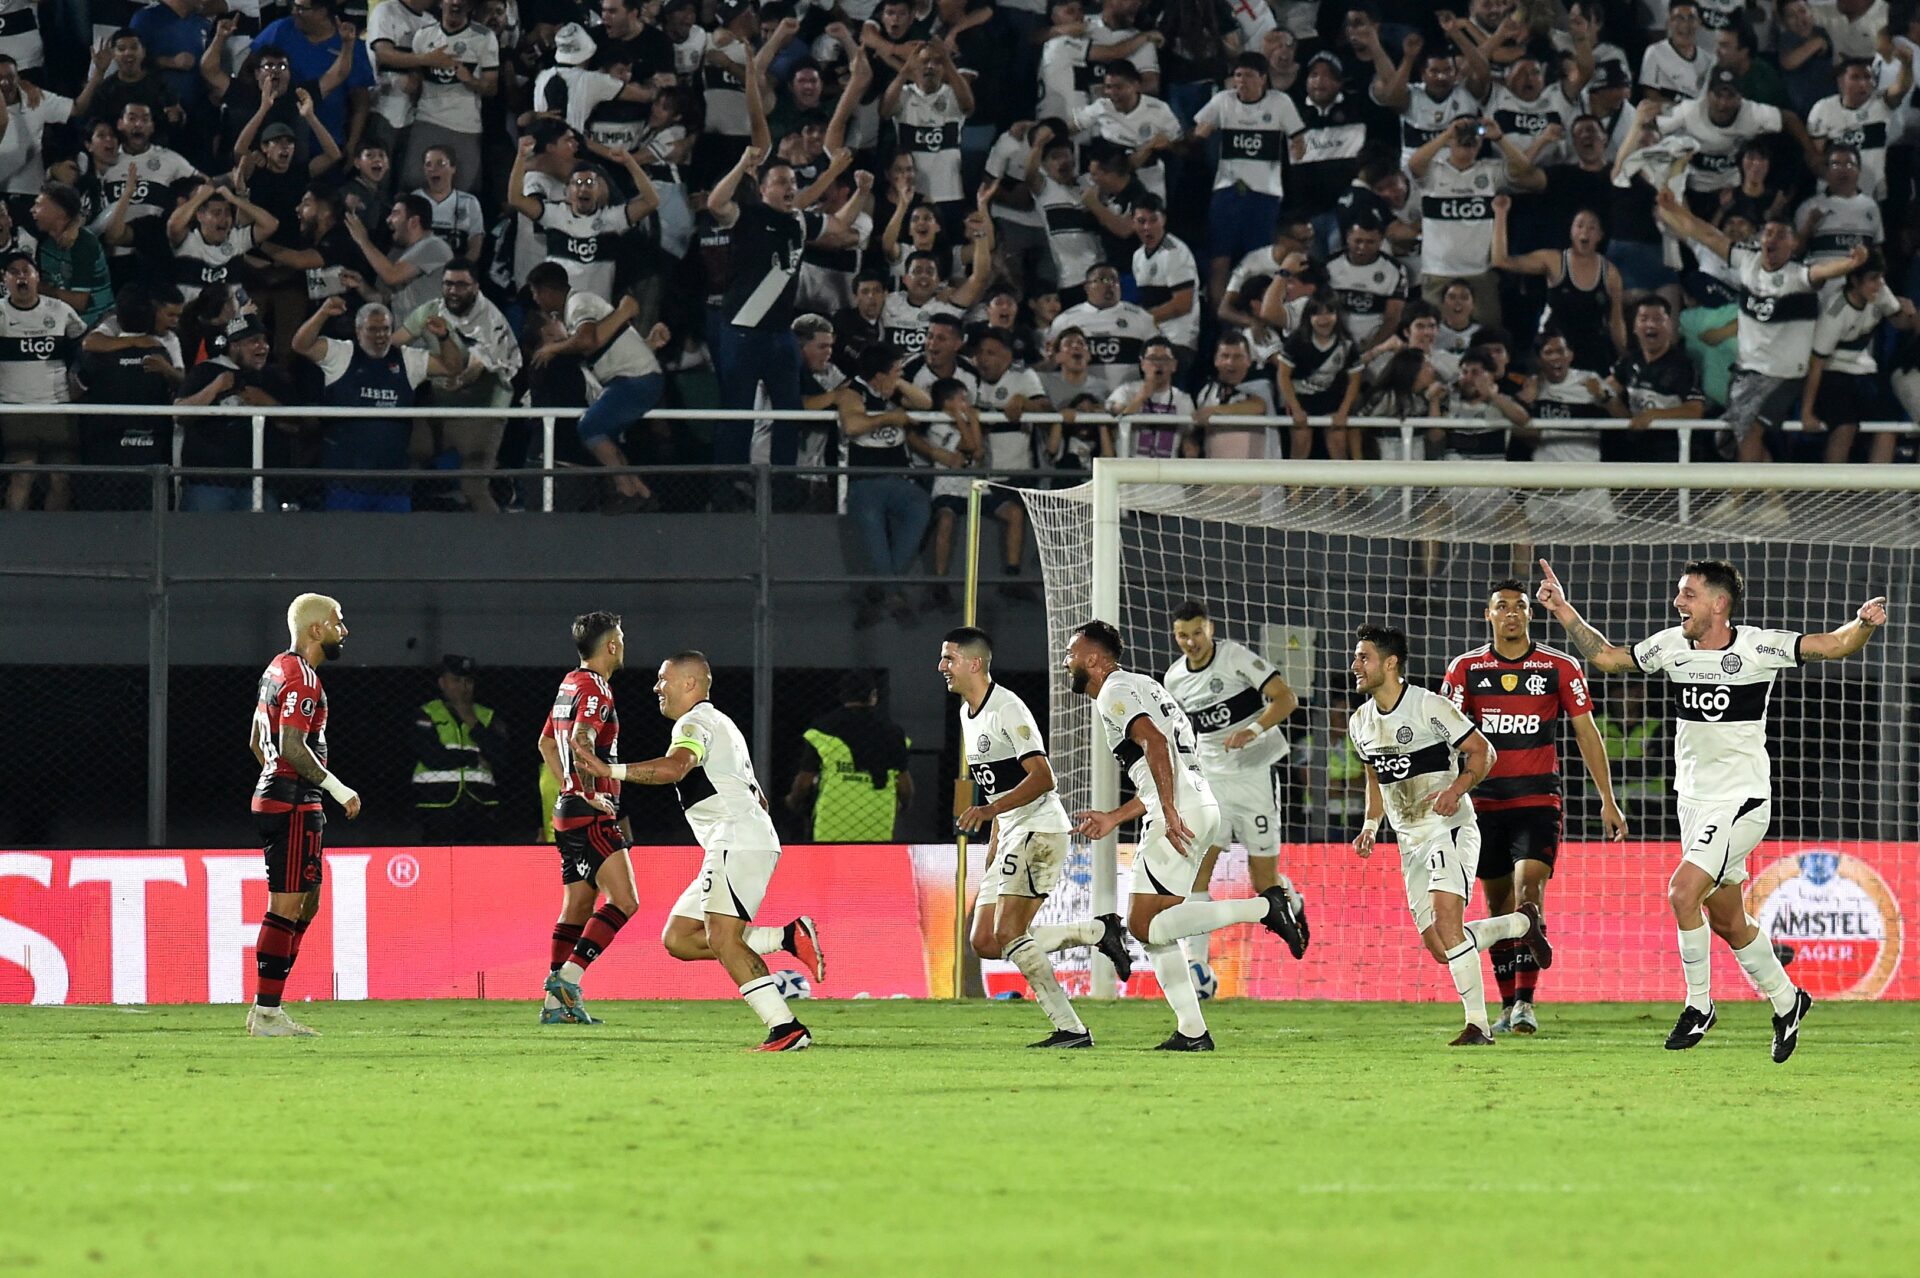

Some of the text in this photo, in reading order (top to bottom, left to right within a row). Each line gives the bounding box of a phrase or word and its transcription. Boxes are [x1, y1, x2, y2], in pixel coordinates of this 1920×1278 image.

[1499, 714, 1541, 735] BRB
[1254, 814, 1268, 835] 9
[1698, 825, 1718, 845] 3
[1771, 911, 1870, 937] AMSTEL
